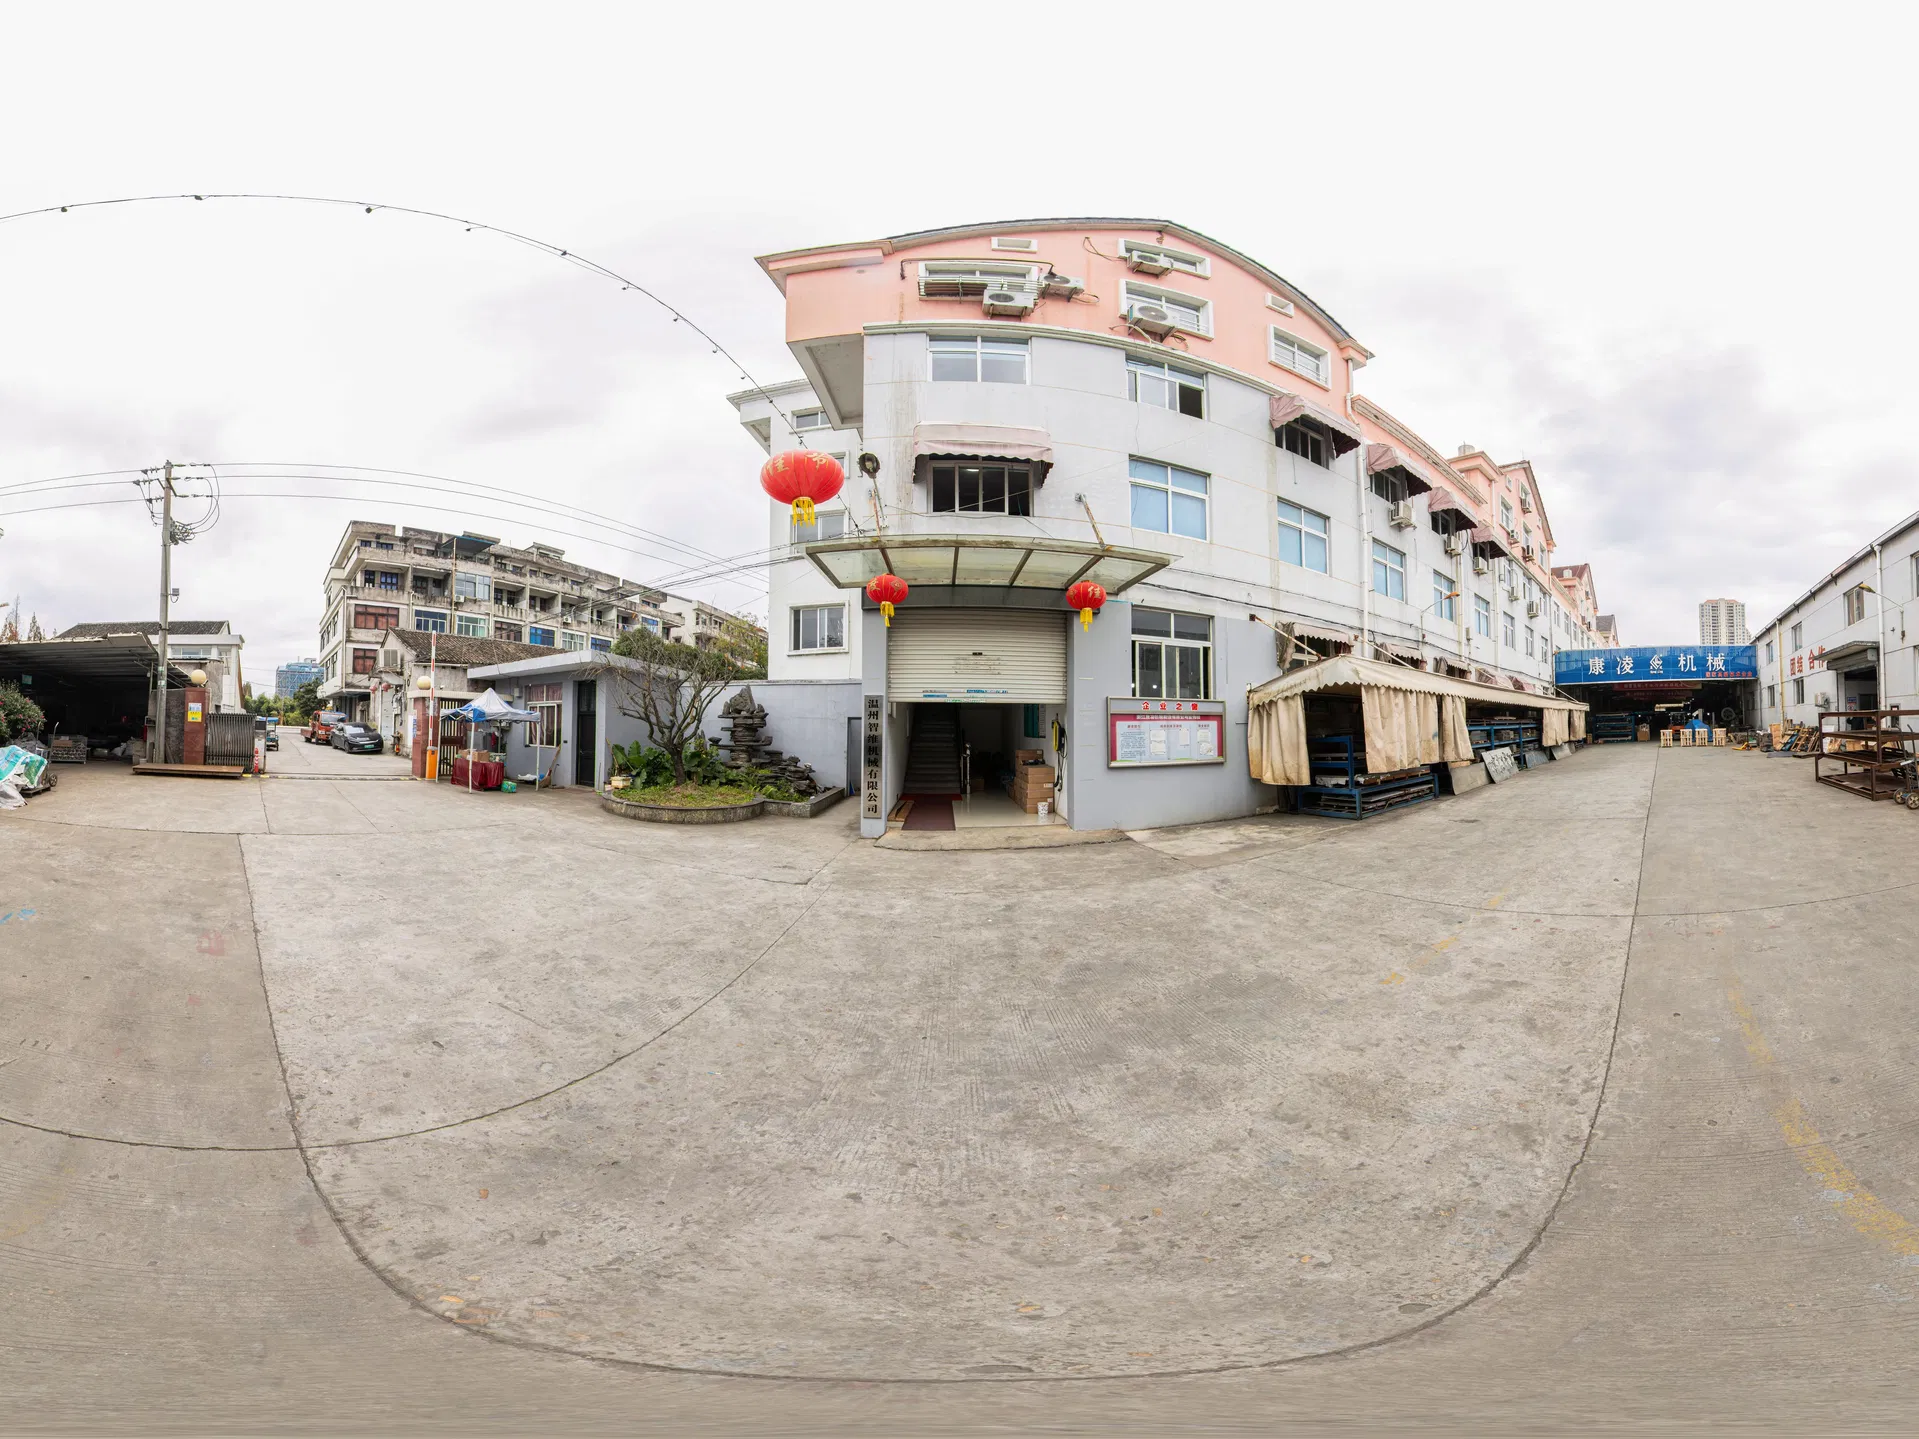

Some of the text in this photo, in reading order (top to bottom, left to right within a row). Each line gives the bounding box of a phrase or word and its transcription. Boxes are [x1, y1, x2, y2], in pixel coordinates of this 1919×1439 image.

[1588, 653, 1726, 675] 康凌机械
[867, 699, 879, 814] 温州智维机械有限公司
